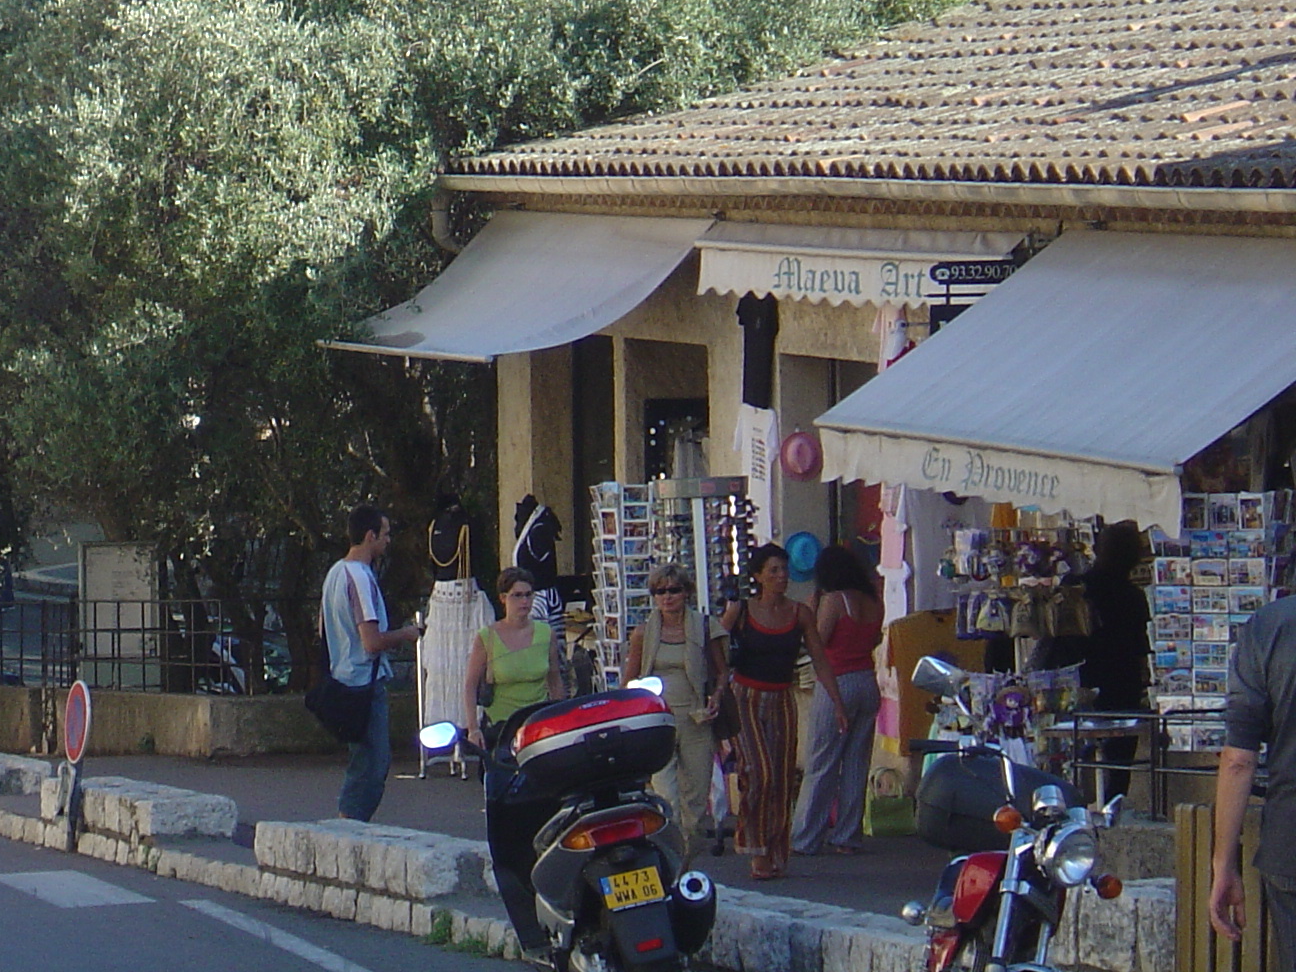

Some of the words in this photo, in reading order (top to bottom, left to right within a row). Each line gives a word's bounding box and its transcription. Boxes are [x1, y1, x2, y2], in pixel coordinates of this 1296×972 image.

[773, 257, 862, 295] Maeva
[880, 261, 925, 298] Art
[921, 446, 951, 482] En
[962, 450, 1060, 499] Provence
[612, 870, 650, 888] 4473
[642, 883, 658, 898] 06
